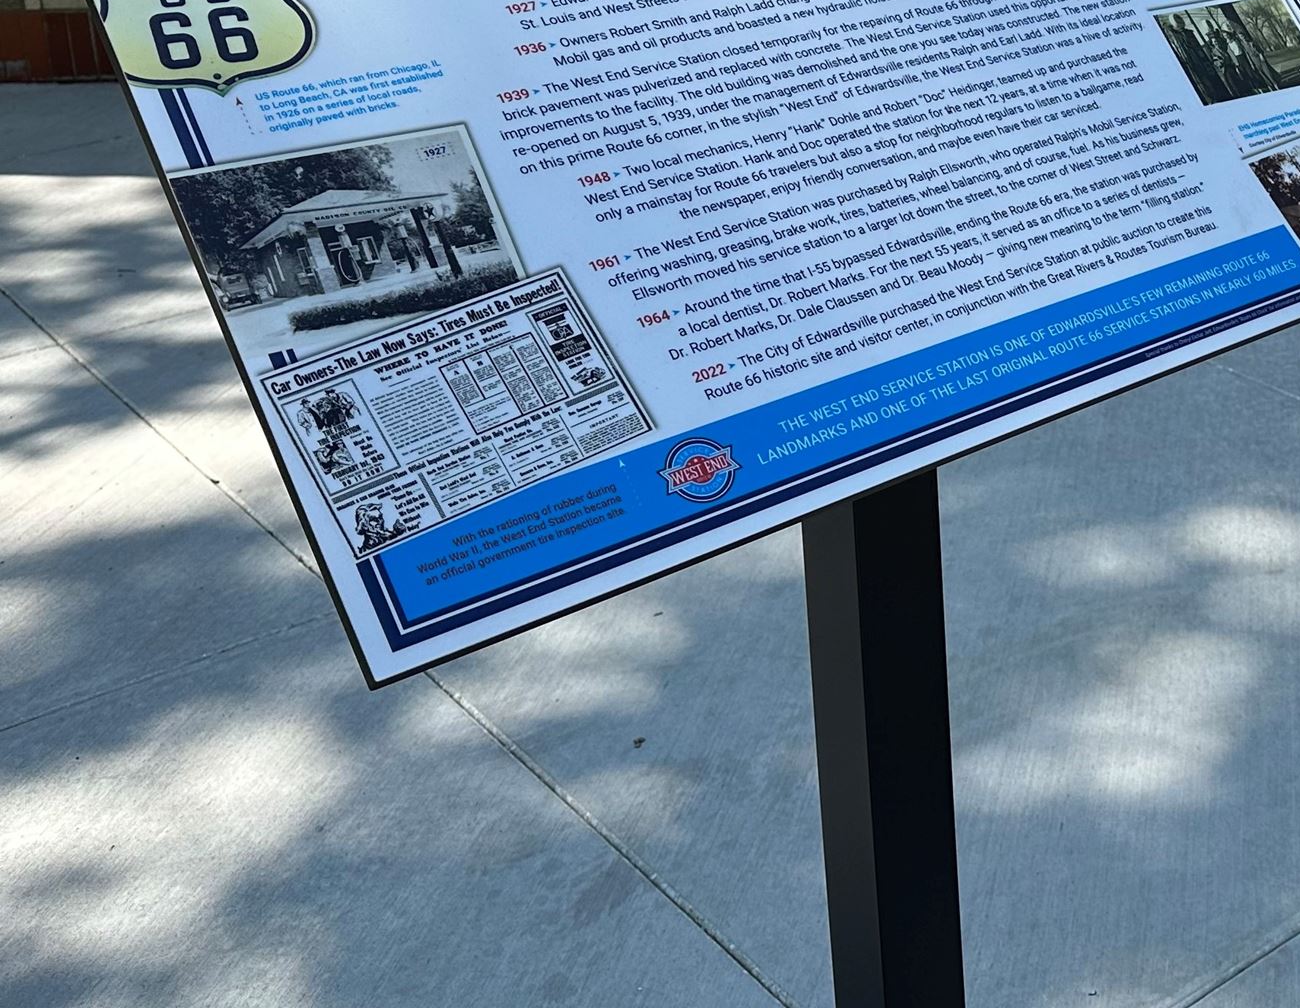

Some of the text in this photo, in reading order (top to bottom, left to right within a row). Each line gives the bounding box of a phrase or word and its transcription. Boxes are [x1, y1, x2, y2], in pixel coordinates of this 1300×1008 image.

[149, 6, 259, 70] 66
[505, 0, 535, 14] 1927
[552, 49, 590, 66] Mobil
[591, 47, 616, 61] gas
[617, 40, 641, 54] and
[642, 36, 658, 49] oil
[658, 28, 712, 48] products
[713, 21, 736, 35] and
[734, 12, 782, 30] boasted
[782, 13, 791, 21] a
[791, 8, 815, 19] new
[254, 59, 441, 101] US Route 66, which ran from Chicago, IL
[424, 146, 447, 158] 1927
[678, 99, 1101, 220] the newspaper, enjoy friendly conversation, and maybe even have their car serviced.
[588, 254, 621, 271] 1961
[633, 245, 661, 259] The
[660, 234, 696, 252] West
[695, 226, 722, 243] End
[721, 216, 768, 235] Service
[767, 204, 811, 222] Station
[810, 197, 836, 210] was
[836, 178, 894, 206] purchased
[892, 177, 908, 188] by
[907, 167, 940, 184] Ralph
[938, 154, 990, 175] Ellsworth,
[988, 149, 1011, 161] who
[1011, 135, 1055, 156] operated
[1053, 127, 1088, 143] Ralph's
[1087, 118, 1115, 134] Mobil
[1113, 111, 1148, 126] Service
[691, 206, 1212, 383] 2022 The City of Edwardsville purchased the West End Service Station at public auction to create this
[271, 279, 562, 395] Car Owners-The Law Now Says: Tires Must Be Inspected!
[777, 413, 810, 432] THE
[808, 398, 848, 422] WEST
[850, 388, 879, 408] END
[880, 367, 936, 396] SERVICE
[935, 349, 990, 376] STATION
[988, 344, 1004, 357] IS
[1003, 334, 1031, 352] ONE
[1030, 327, 1046, 342] OF
[1139, 286, 1164, 303] FEW
[1163, 266, 1223, 294] REMAINING
[1221, 254, 1257, 274] ROUTE
[1256, 250, 1270, 262] 66
[670, 455, 729, 485] WEST END
